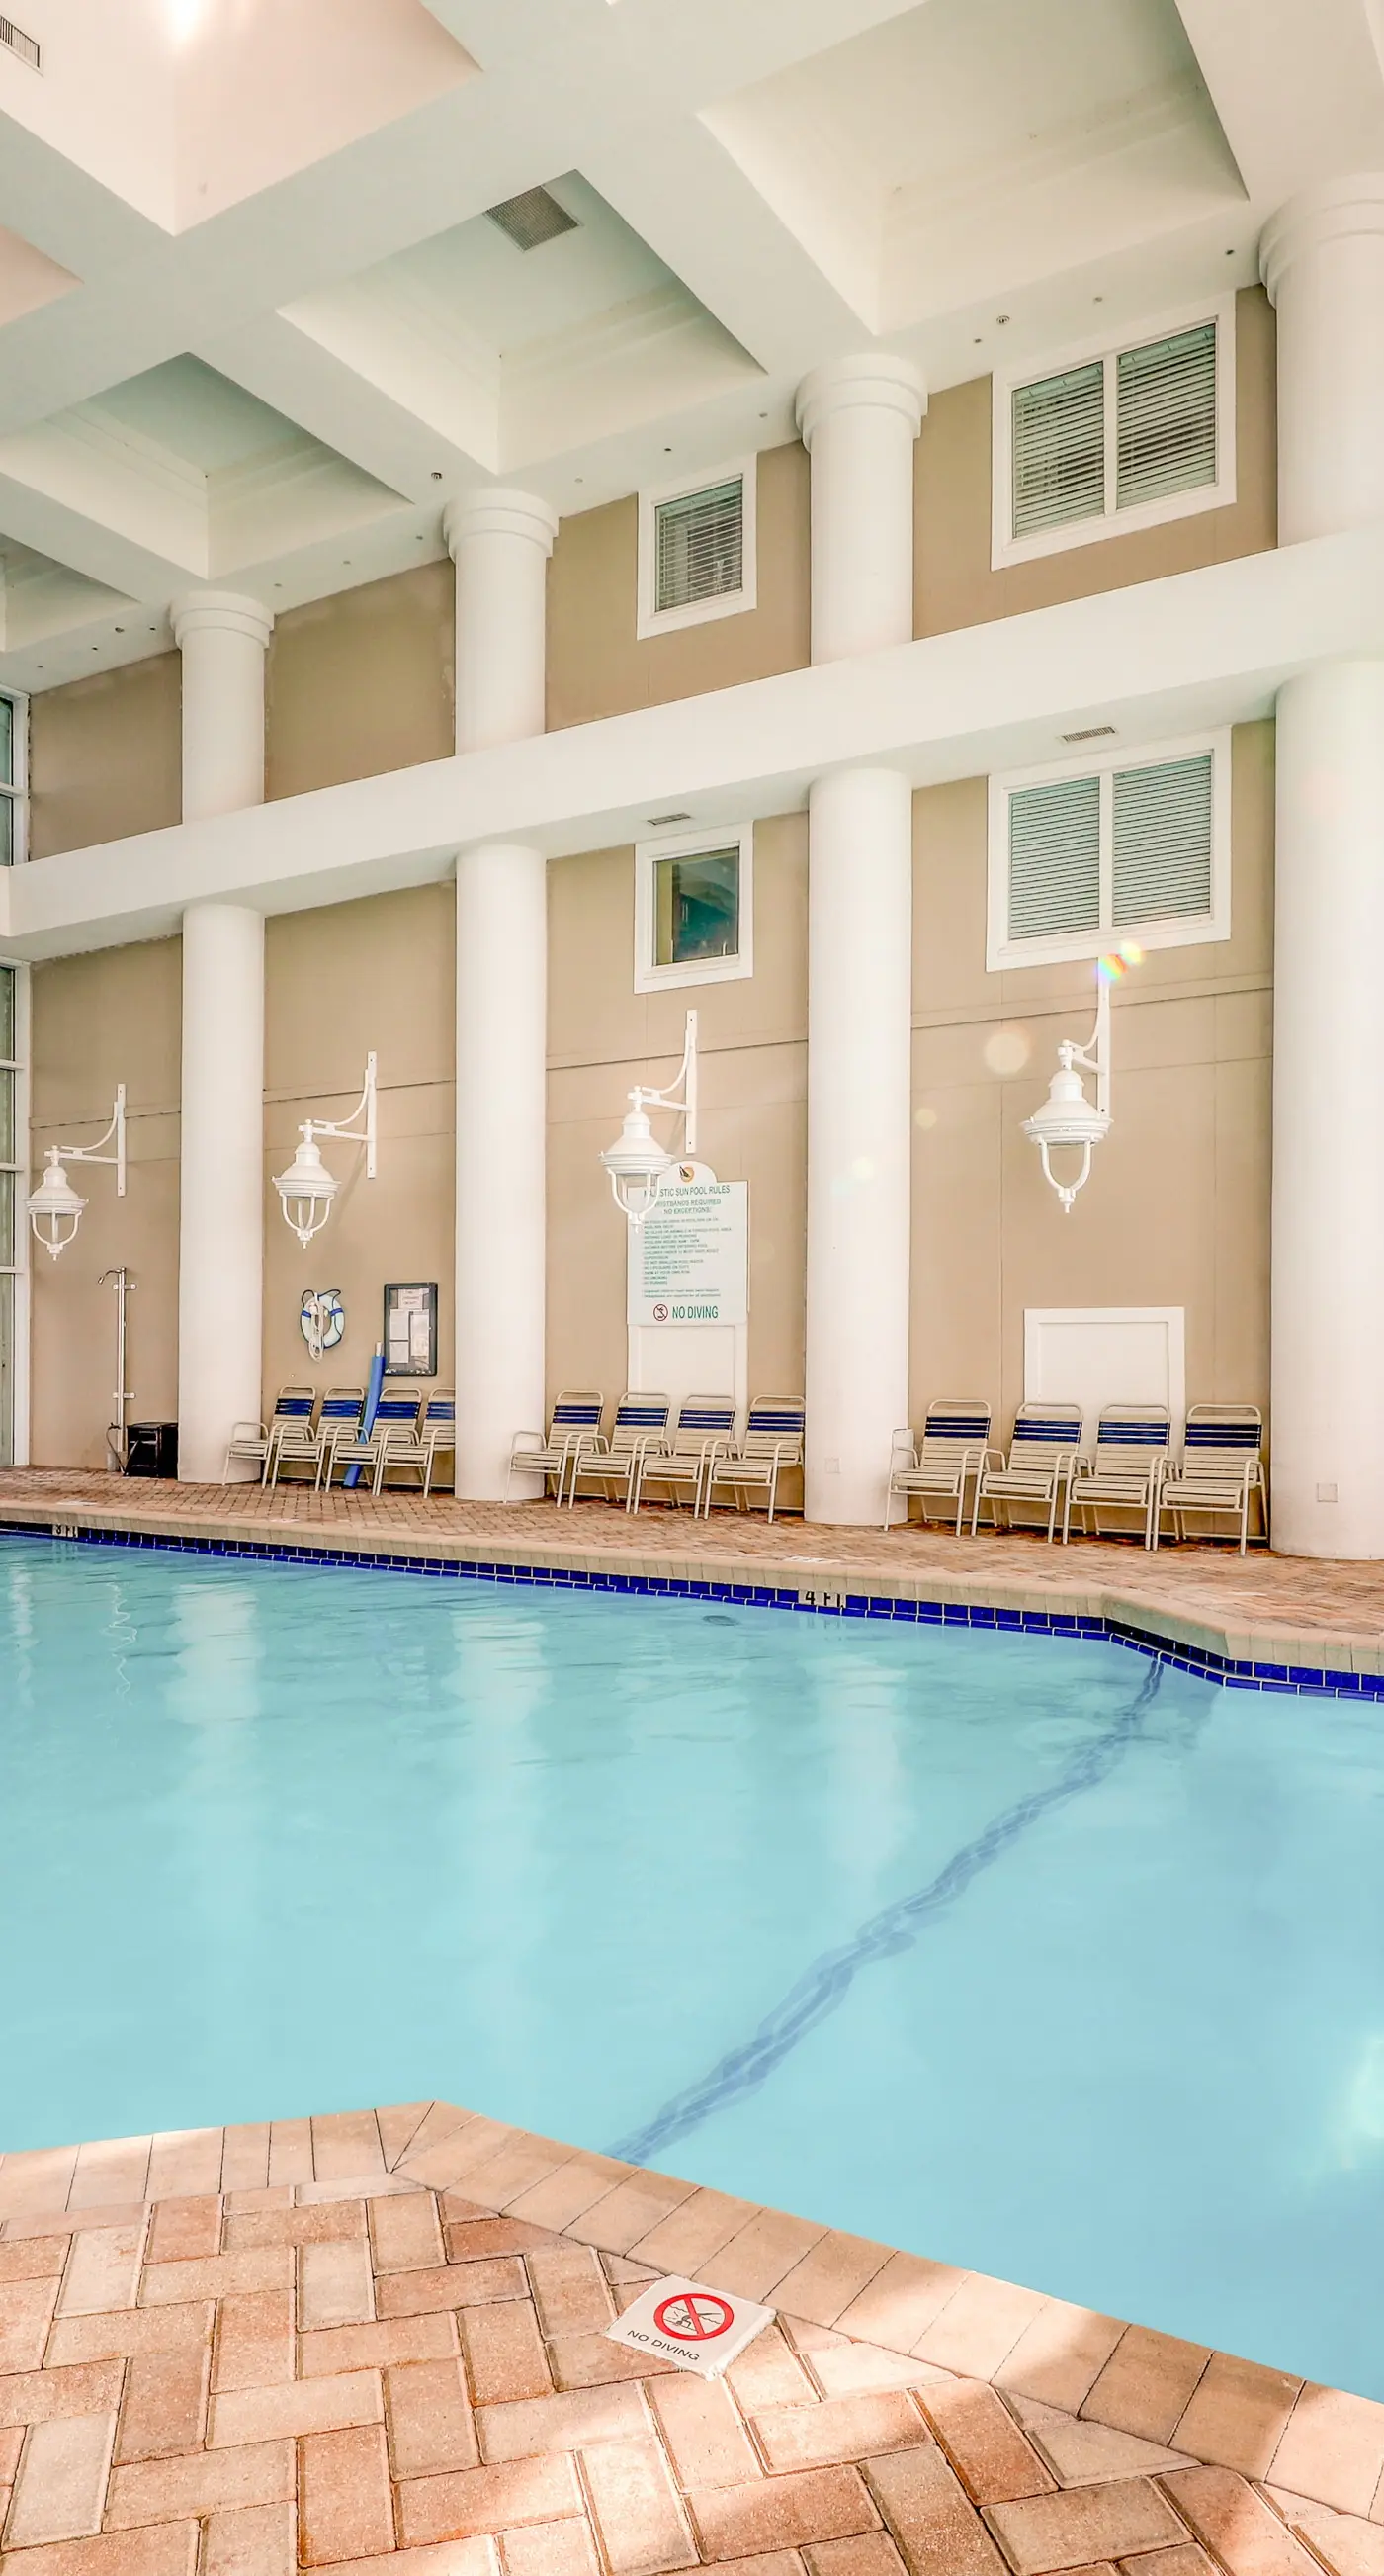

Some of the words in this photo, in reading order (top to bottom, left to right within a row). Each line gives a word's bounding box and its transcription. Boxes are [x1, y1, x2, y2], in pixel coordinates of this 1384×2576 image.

[675, 1187, 689, 1197] SUN
[690, 1186, 707, 1195] POOL
[708, 1185, 730, 1194] RULES
[672, 1306, 685, 1319] NO
[687, 1305, 719, 1319] DIVING
[805, 1591, 816, 1605] 4
[627, 2329, 649, 2342] NO
[651, 2339, 700, 2361] DIVING
